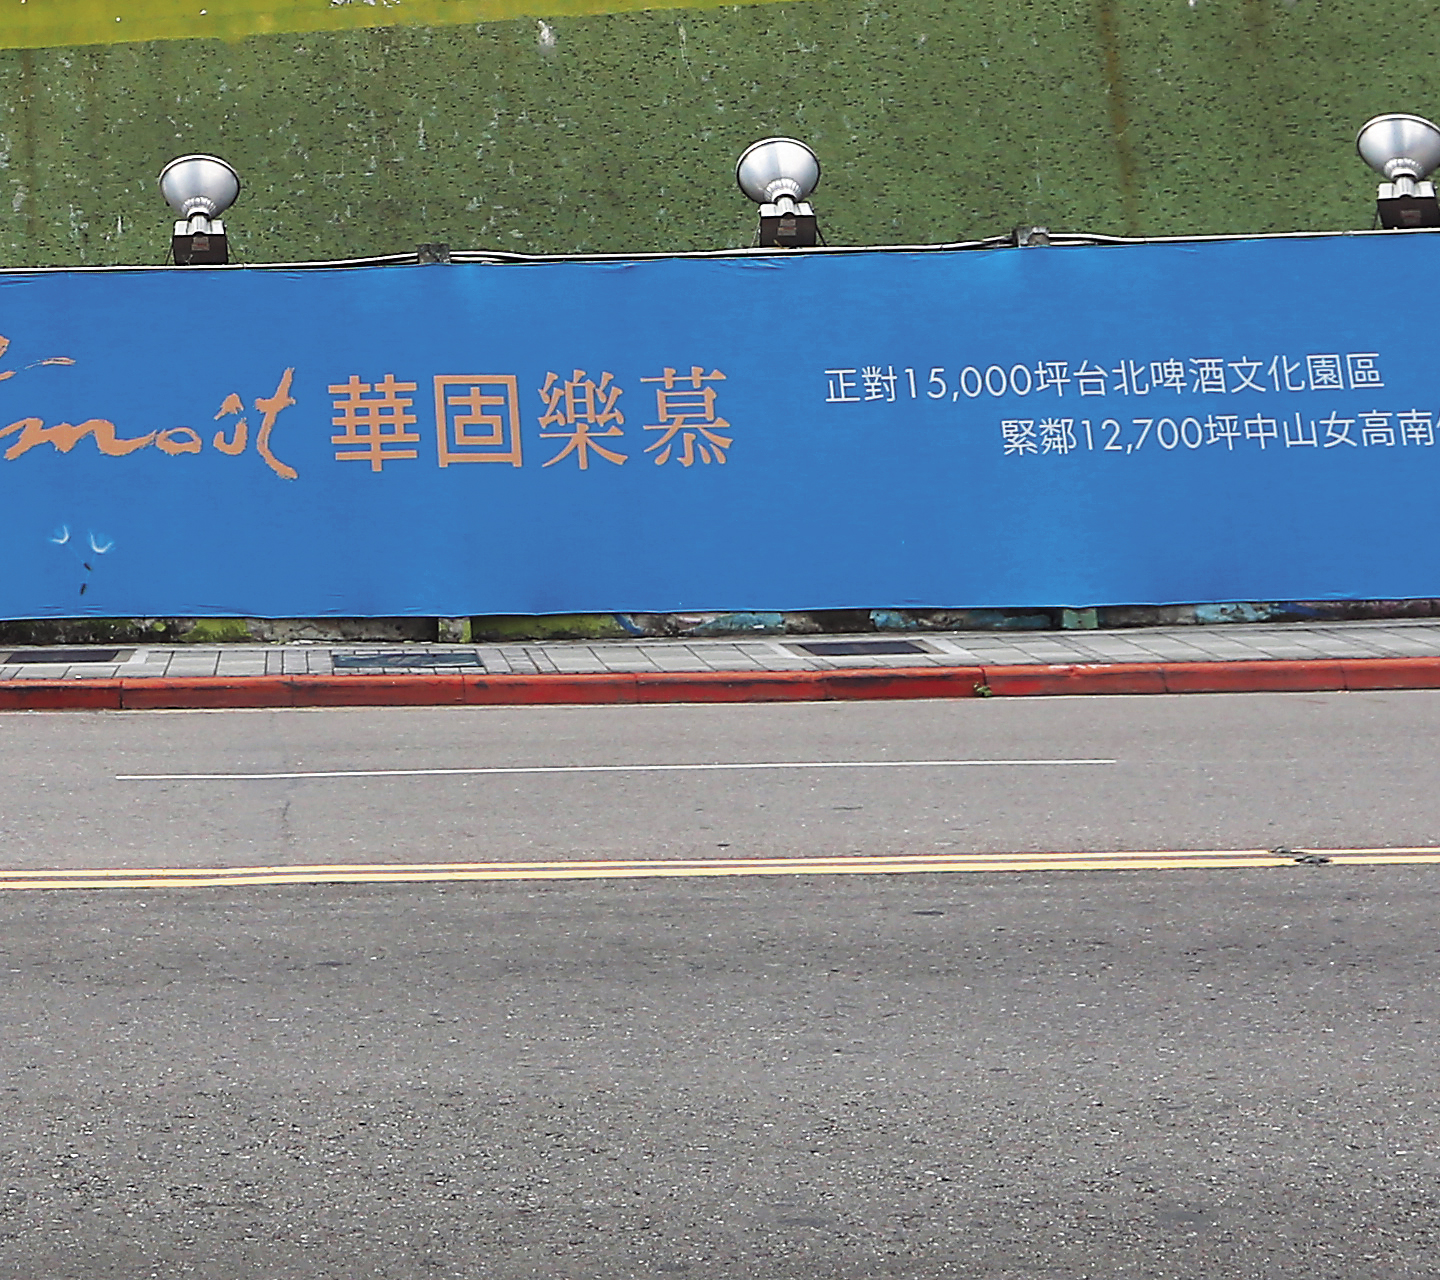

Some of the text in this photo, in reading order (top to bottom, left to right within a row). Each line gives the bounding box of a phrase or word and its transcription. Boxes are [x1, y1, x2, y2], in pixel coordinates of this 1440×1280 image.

[824, 351, 1385, 403] 正對15,000坪台北啤酒文化園區
[328, 367, 734, 472] 華固樂慕
